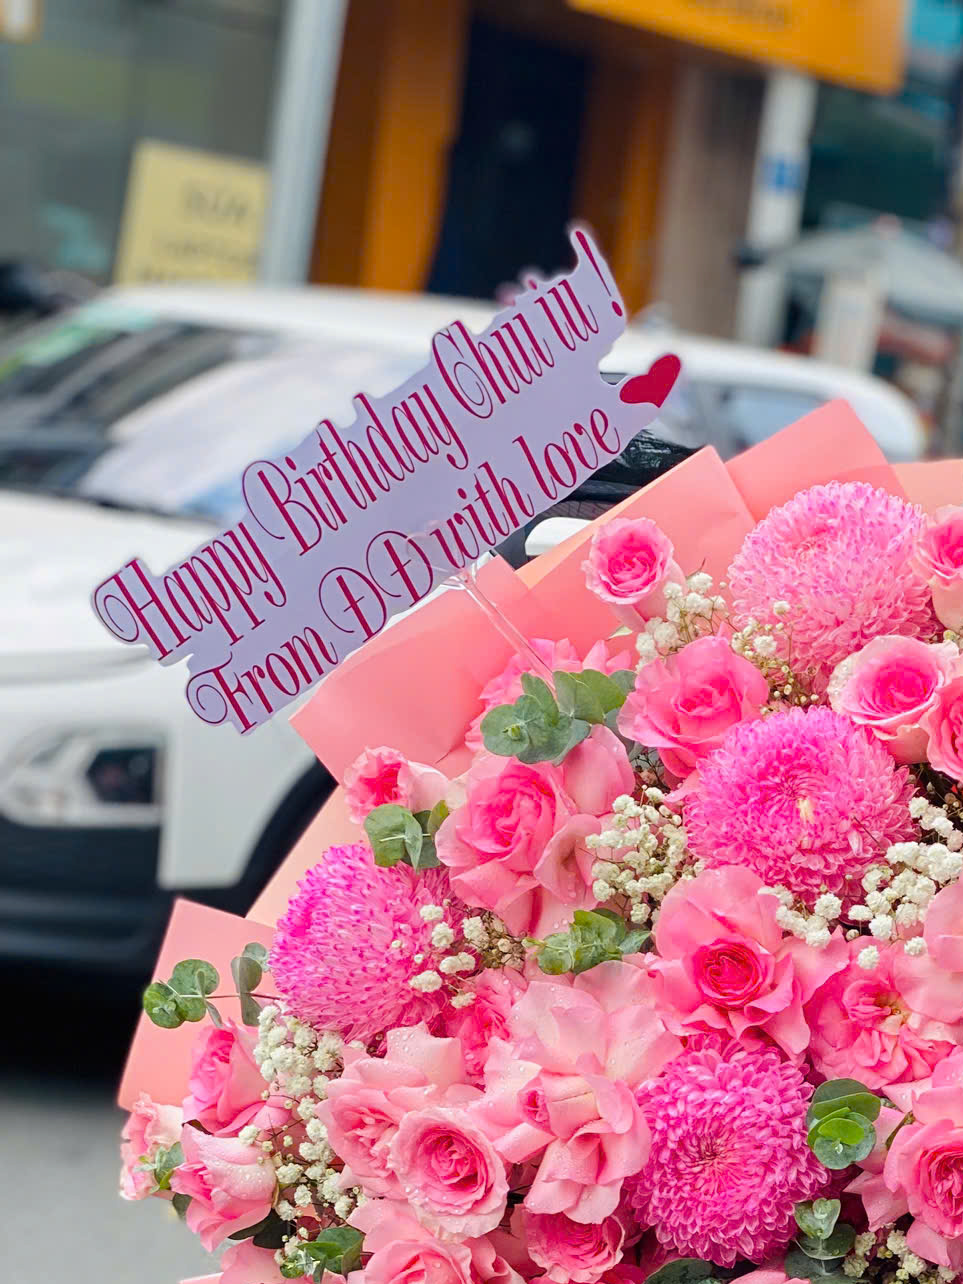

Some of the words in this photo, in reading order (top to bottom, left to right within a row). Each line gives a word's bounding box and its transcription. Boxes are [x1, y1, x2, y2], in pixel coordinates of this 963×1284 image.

[94, 522, 287, 661] Happy
[242, 384, 469, 556] Birthday
[186, 626, 339, 735] From
[429, 461, 535, 570] with
[512, 408, 621, 500] love
